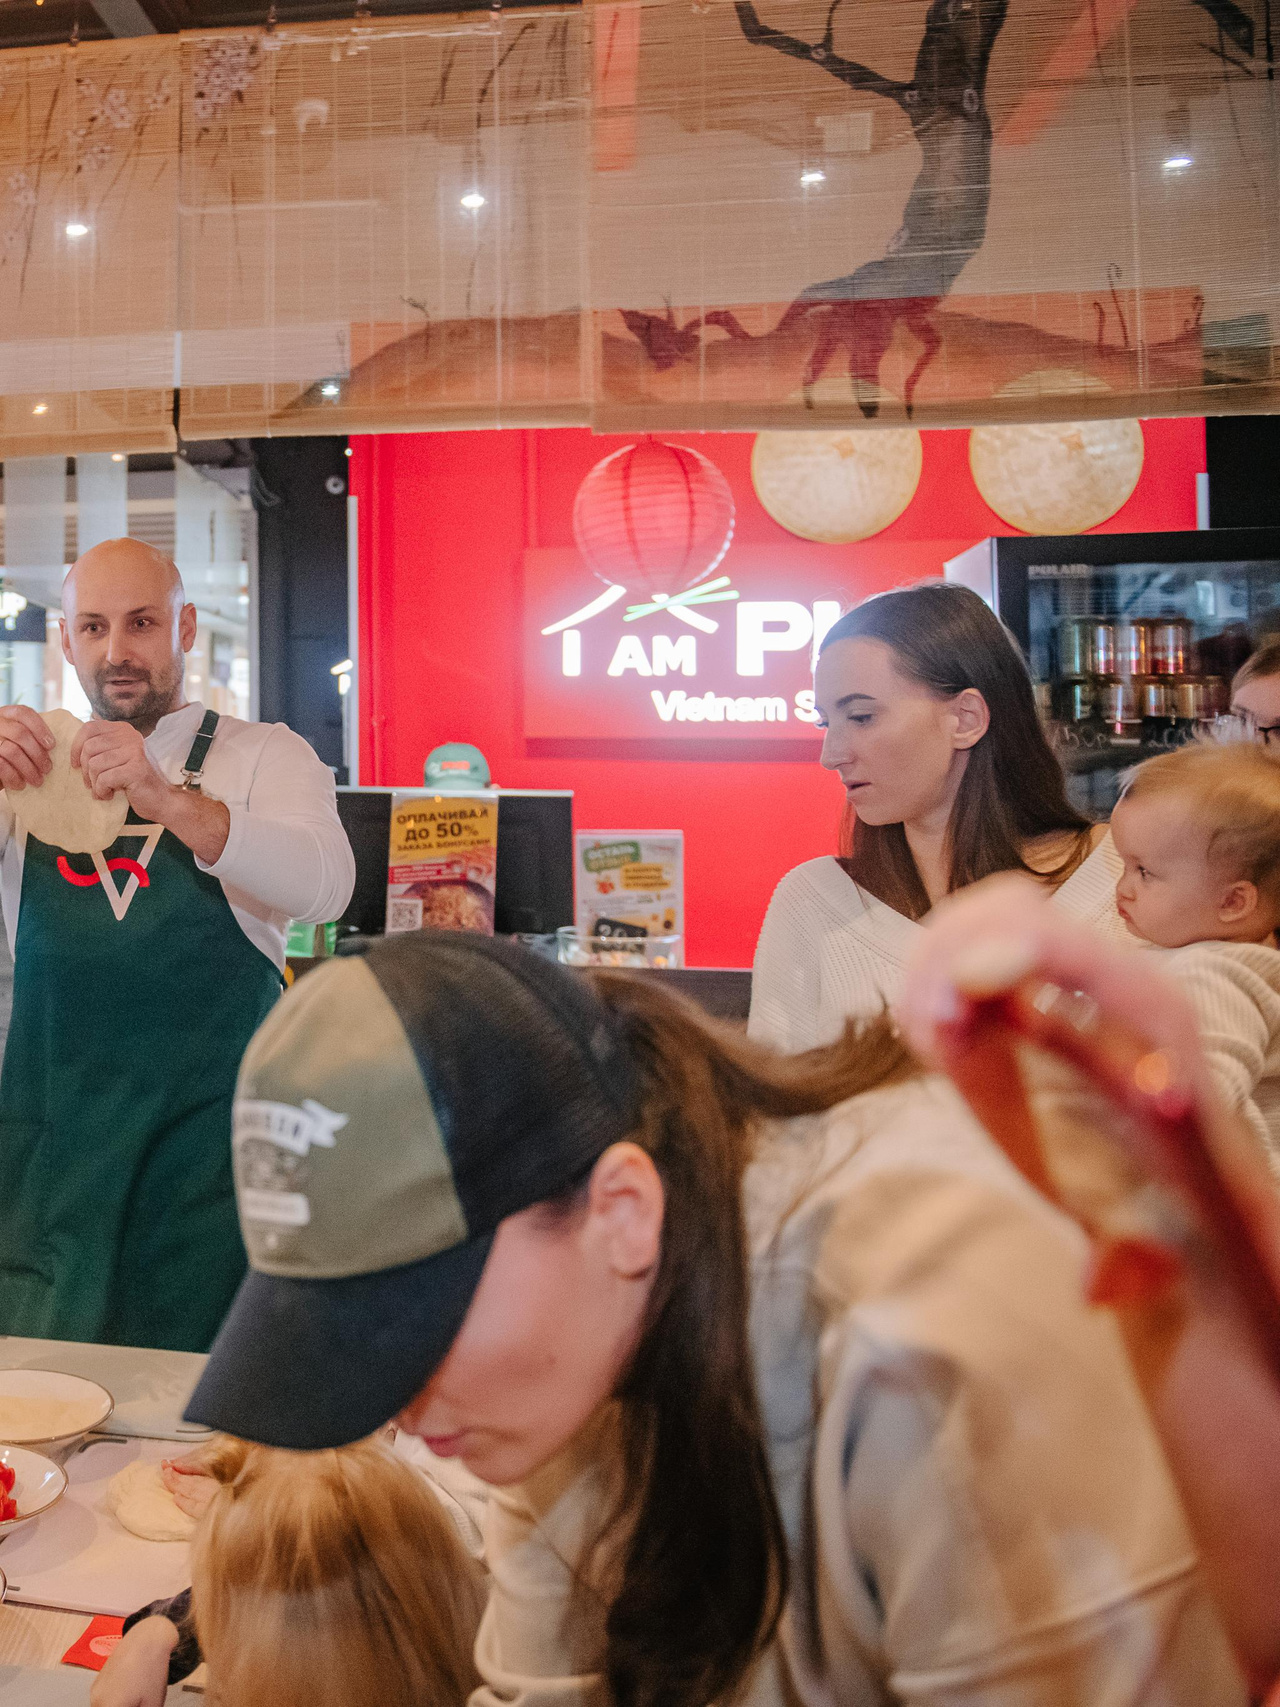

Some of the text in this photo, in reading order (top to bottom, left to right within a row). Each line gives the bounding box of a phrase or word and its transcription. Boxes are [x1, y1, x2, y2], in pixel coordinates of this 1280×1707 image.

[562, 630, 581, 677] I
[607, 635, 697, 677] AM
[651, 690, 788, 723] Vietnam
[396, 808, 489, 825] ОПЛАЧИВАЙ
[436, 822, 480, 838] 50%
